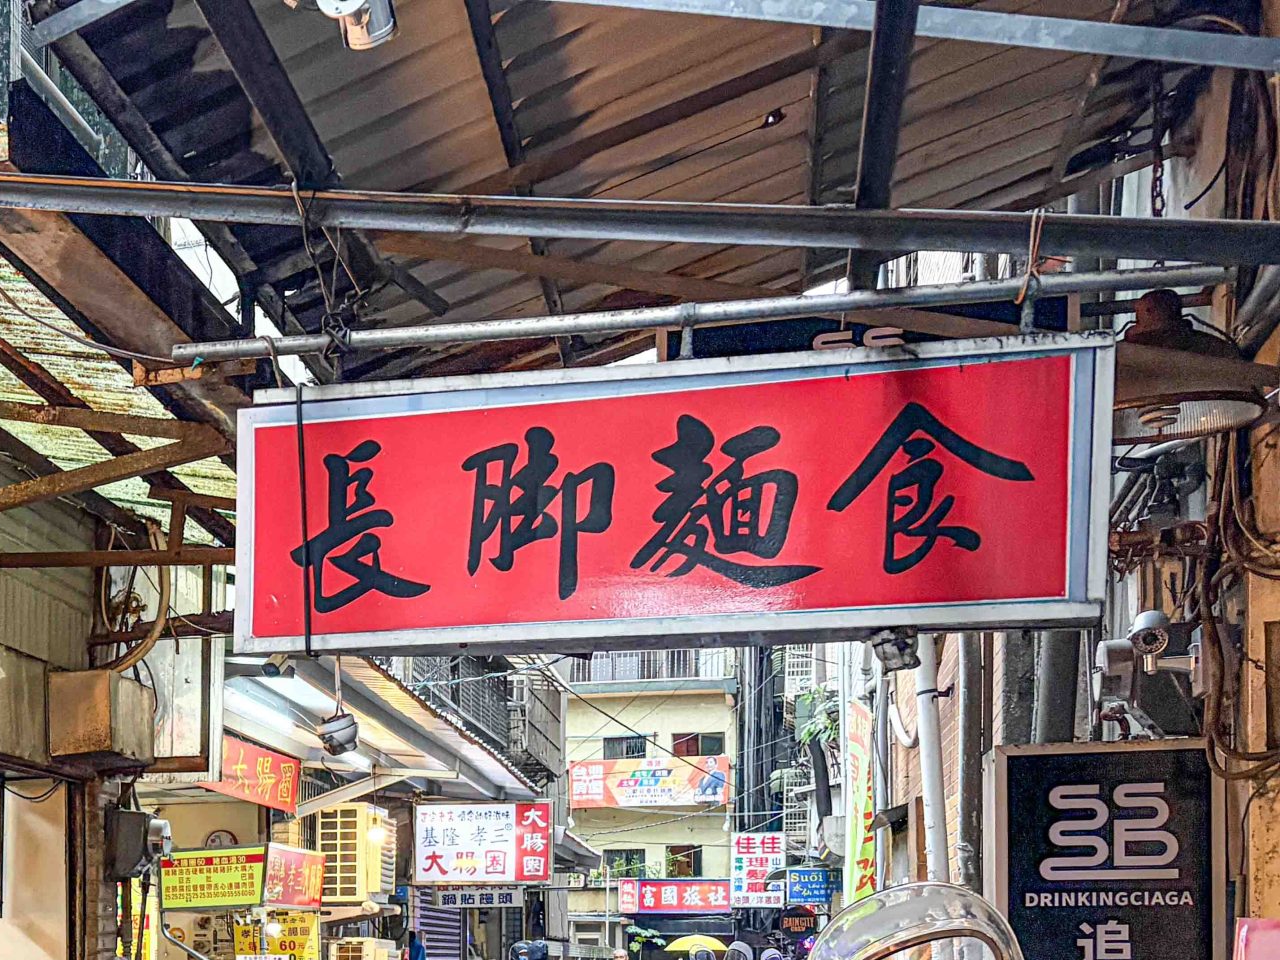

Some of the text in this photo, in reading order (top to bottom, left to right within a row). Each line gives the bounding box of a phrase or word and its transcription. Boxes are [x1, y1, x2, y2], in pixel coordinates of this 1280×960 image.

[735, 836, 781, 854] 佳佳
[642, 885, 728, 907] 富國旅社
[1025, 891, 1194, 907] DRINKINGCIAGA
